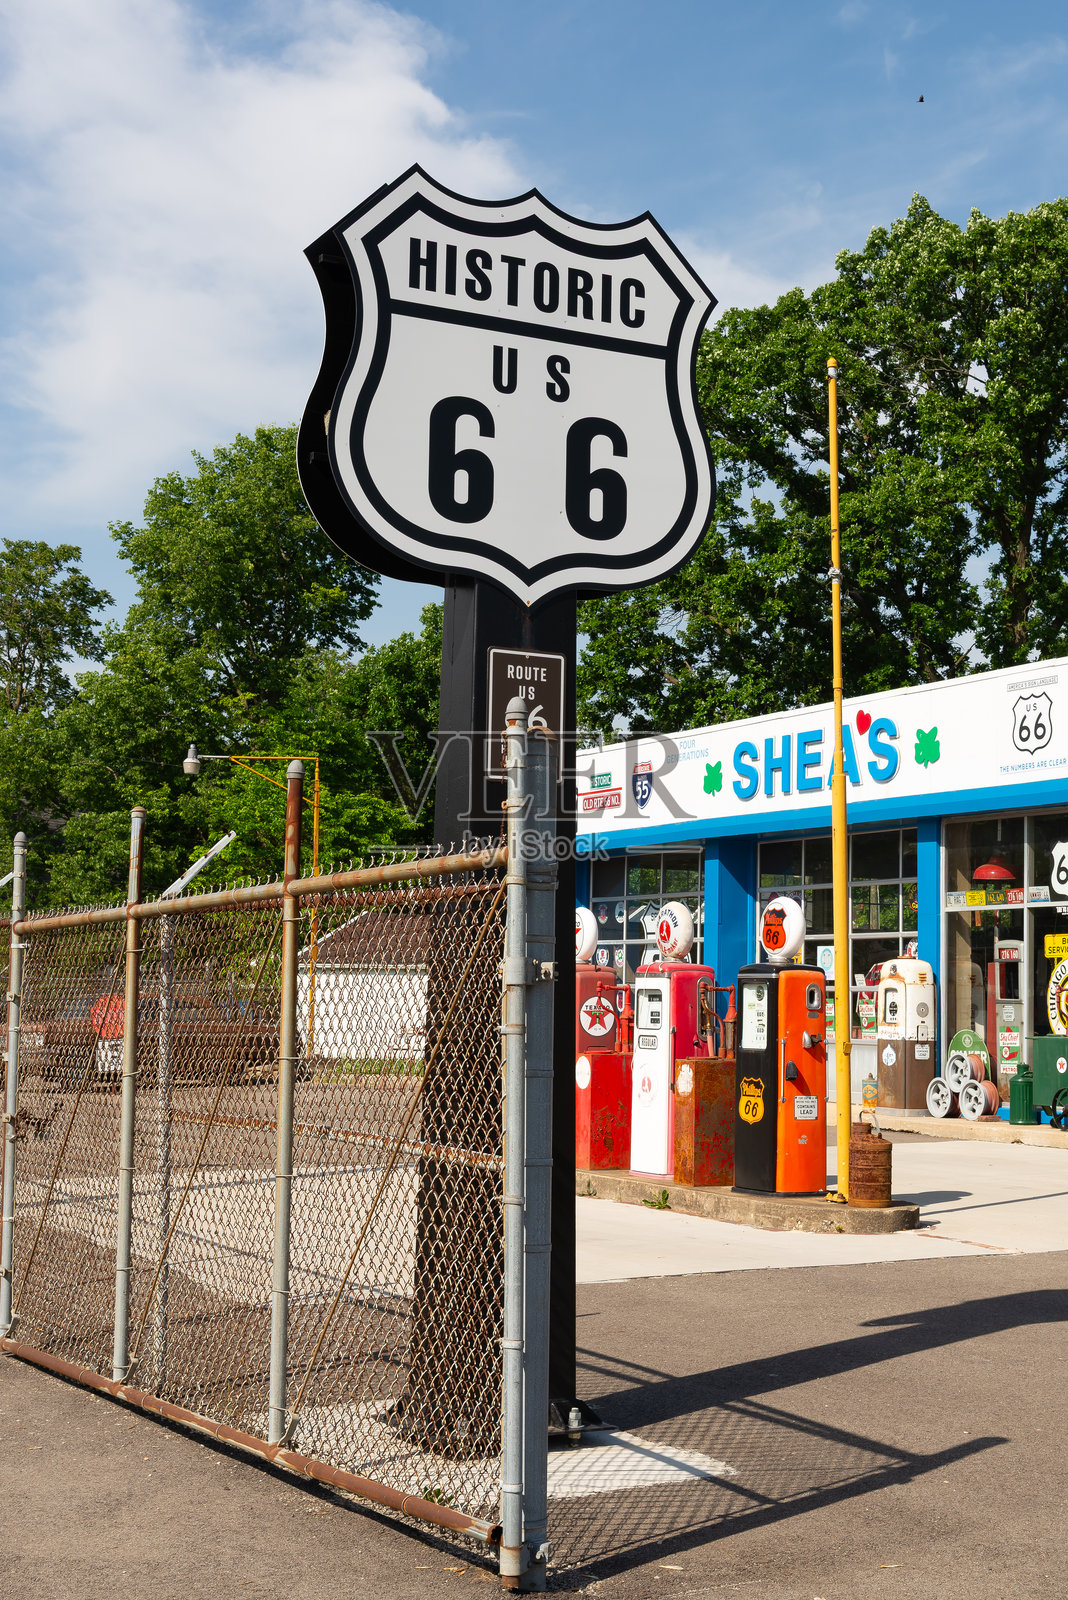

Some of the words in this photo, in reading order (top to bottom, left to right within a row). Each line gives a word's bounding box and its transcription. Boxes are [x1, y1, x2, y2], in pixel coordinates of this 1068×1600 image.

[408, 237, 646, 329] HISTORIC
[507, 664, 547, 682] ROUTE
[518, 685, 535, 700] US
[1025, 702, 1038, 712] US
[1019, 712, 1046, 742] 66
[679, 739, 696, 750] FOUR
[666, 748, 709, 764] GENERATIONS
[1011, 762, 1035, 771] NUMBERS
[1037, 760, 1047, 768] ARE
[1048, 757, 1067, 767] CLEAR
[635, 780, 649, 800] 55
[583, 797, 593, 810] OLD
[593, 796, 604, 808] RTE
[765, 928, 780, 945] 66
[1049, 964, 1067, 1020] CHICAGO
[641, 1037, 656, 1047] REGULAR
[1000, 1033, 1008, 1042] Sky
[1008, 1033, 1019, 1041] Chief
[744, 1099, 759, 1118] 66
